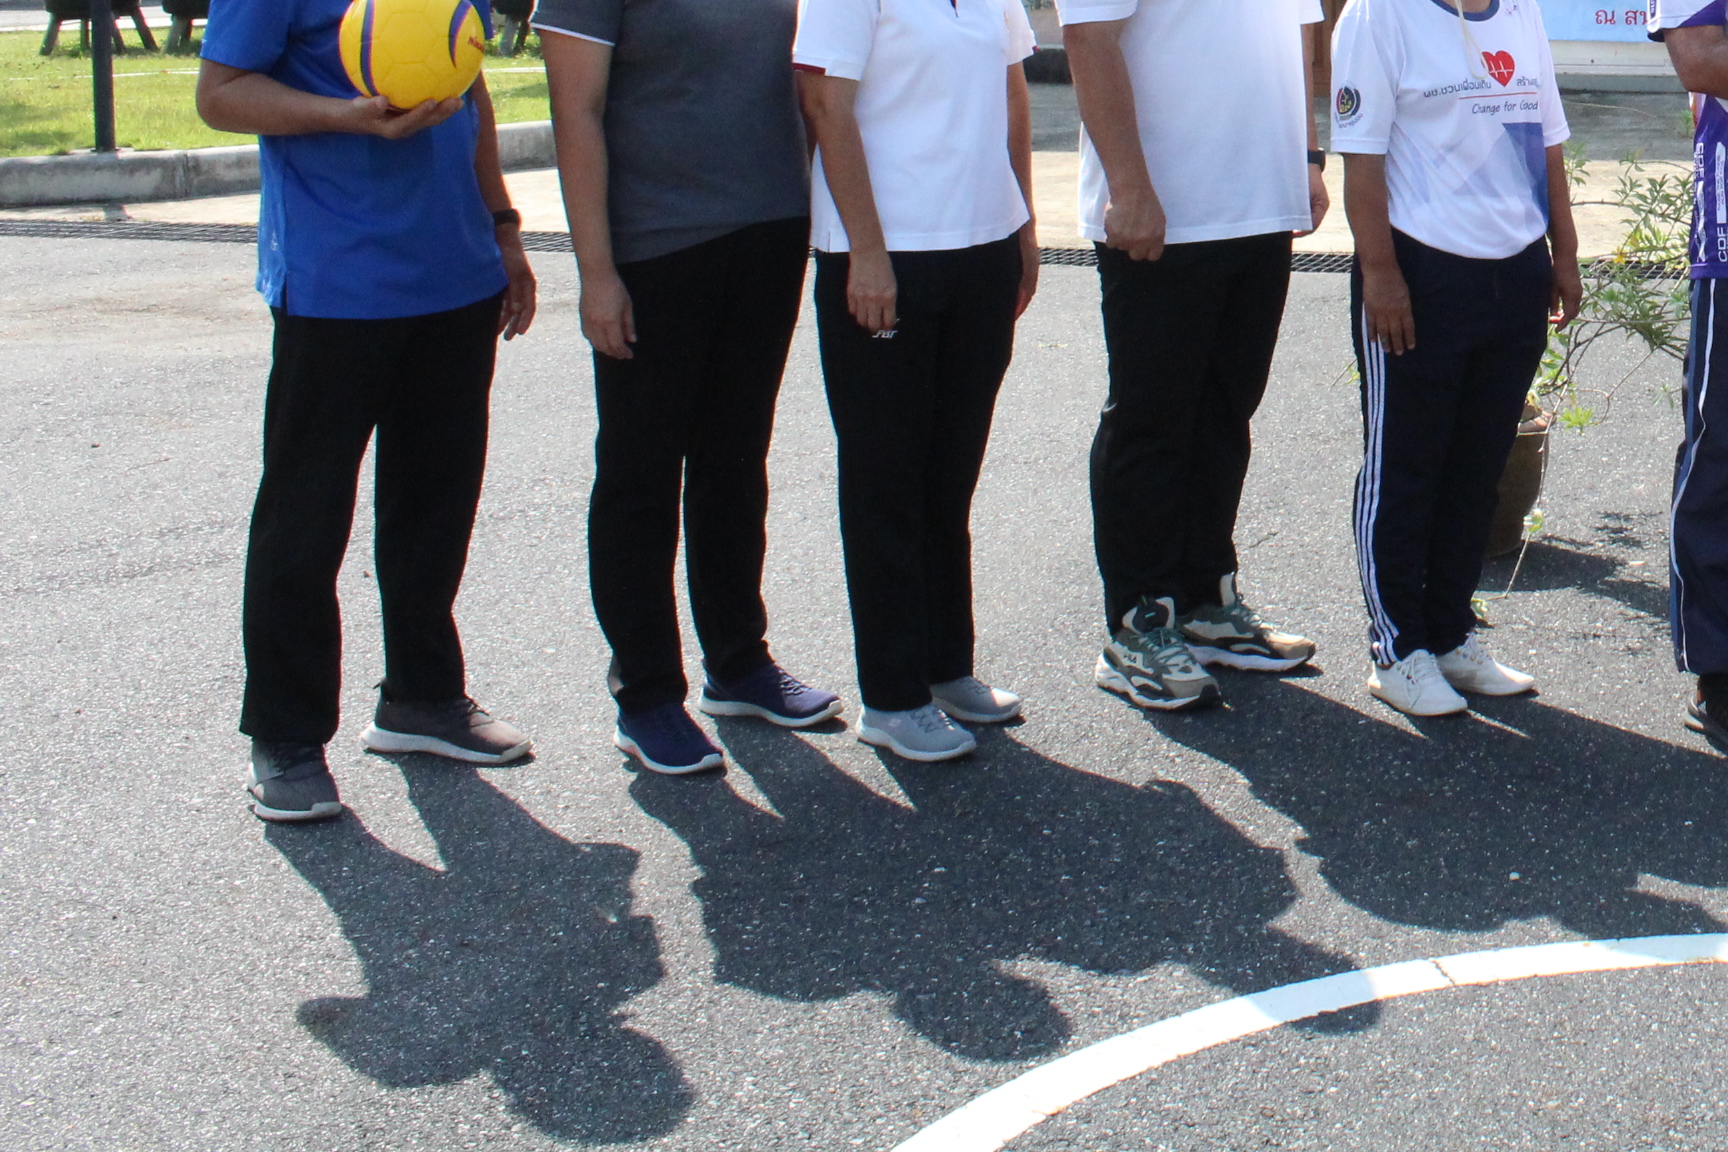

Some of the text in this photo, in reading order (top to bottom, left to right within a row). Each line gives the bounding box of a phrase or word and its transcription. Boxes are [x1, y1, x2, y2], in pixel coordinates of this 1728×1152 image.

[1595, 10, 1616, 25] ณ
[1504, 100, 1517, 112] for
[1717, 227, 1728, 262] CDF
